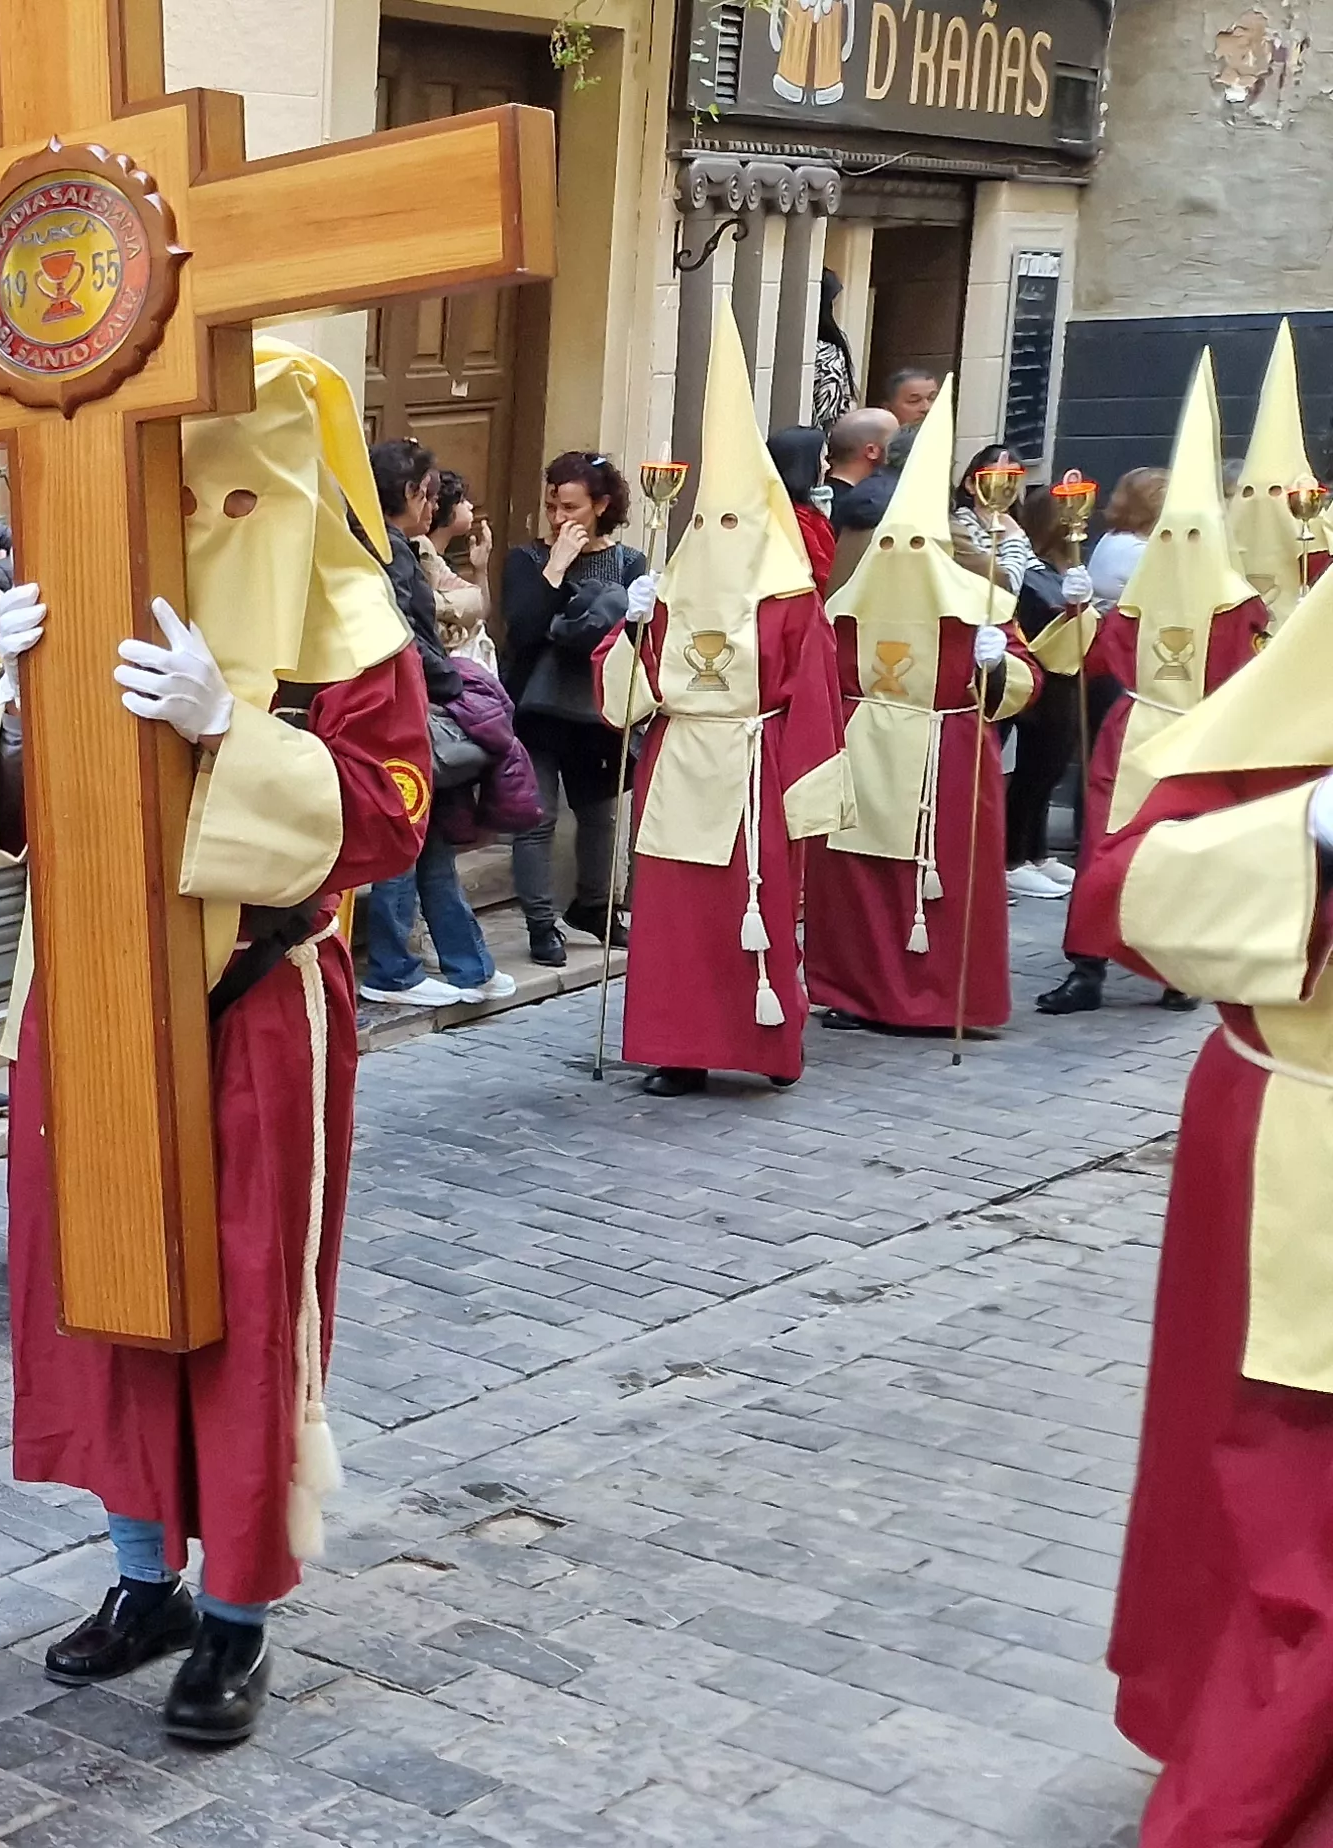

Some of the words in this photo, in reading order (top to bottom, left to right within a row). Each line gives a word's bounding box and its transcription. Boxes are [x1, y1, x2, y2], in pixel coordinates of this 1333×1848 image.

[865, 0, 1052, 118] D'KAÑAS
[2, 270, 28, 308] 19
[91, 249, 120, 292] 55
[14, 343, 92, 368] SANTO
